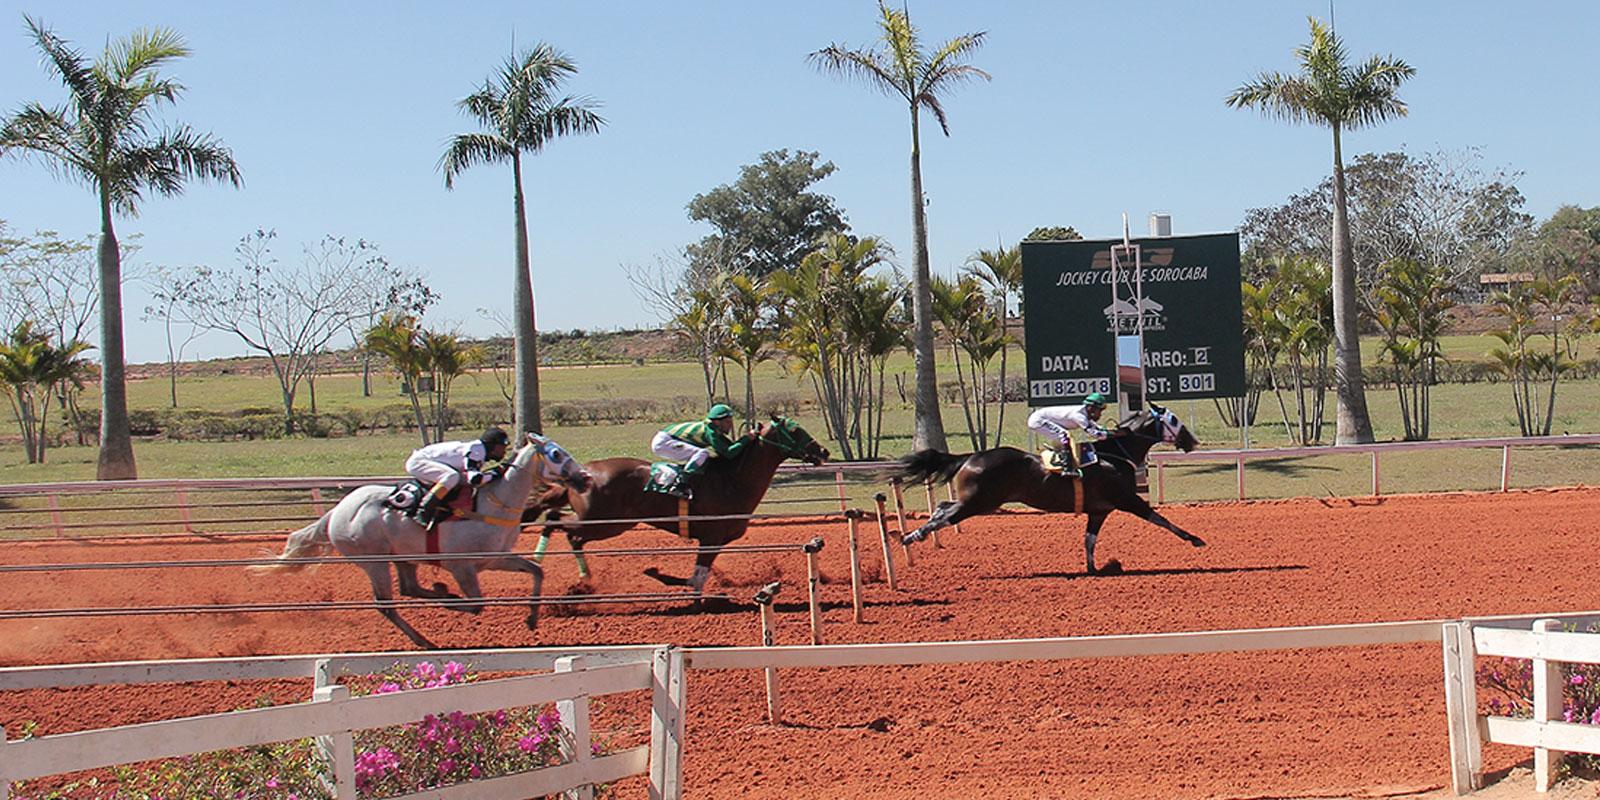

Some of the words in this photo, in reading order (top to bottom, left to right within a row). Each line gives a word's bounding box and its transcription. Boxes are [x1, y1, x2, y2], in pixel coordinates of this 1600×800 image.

[1056, 271, 1100, 286] JOCKEY
[1100, 269, 1130, 284] CLUB
[1149, 267, 1208, 281] SOROCABA
[1042, 355, 1089, 372] DATA:
[1144, 347, 1187, 367] ÁREO:
[1196, 350, 1207, 363] 2
[1148, 377, 1171, 394] ST:
[1180, 375, 1214, 391] 301
